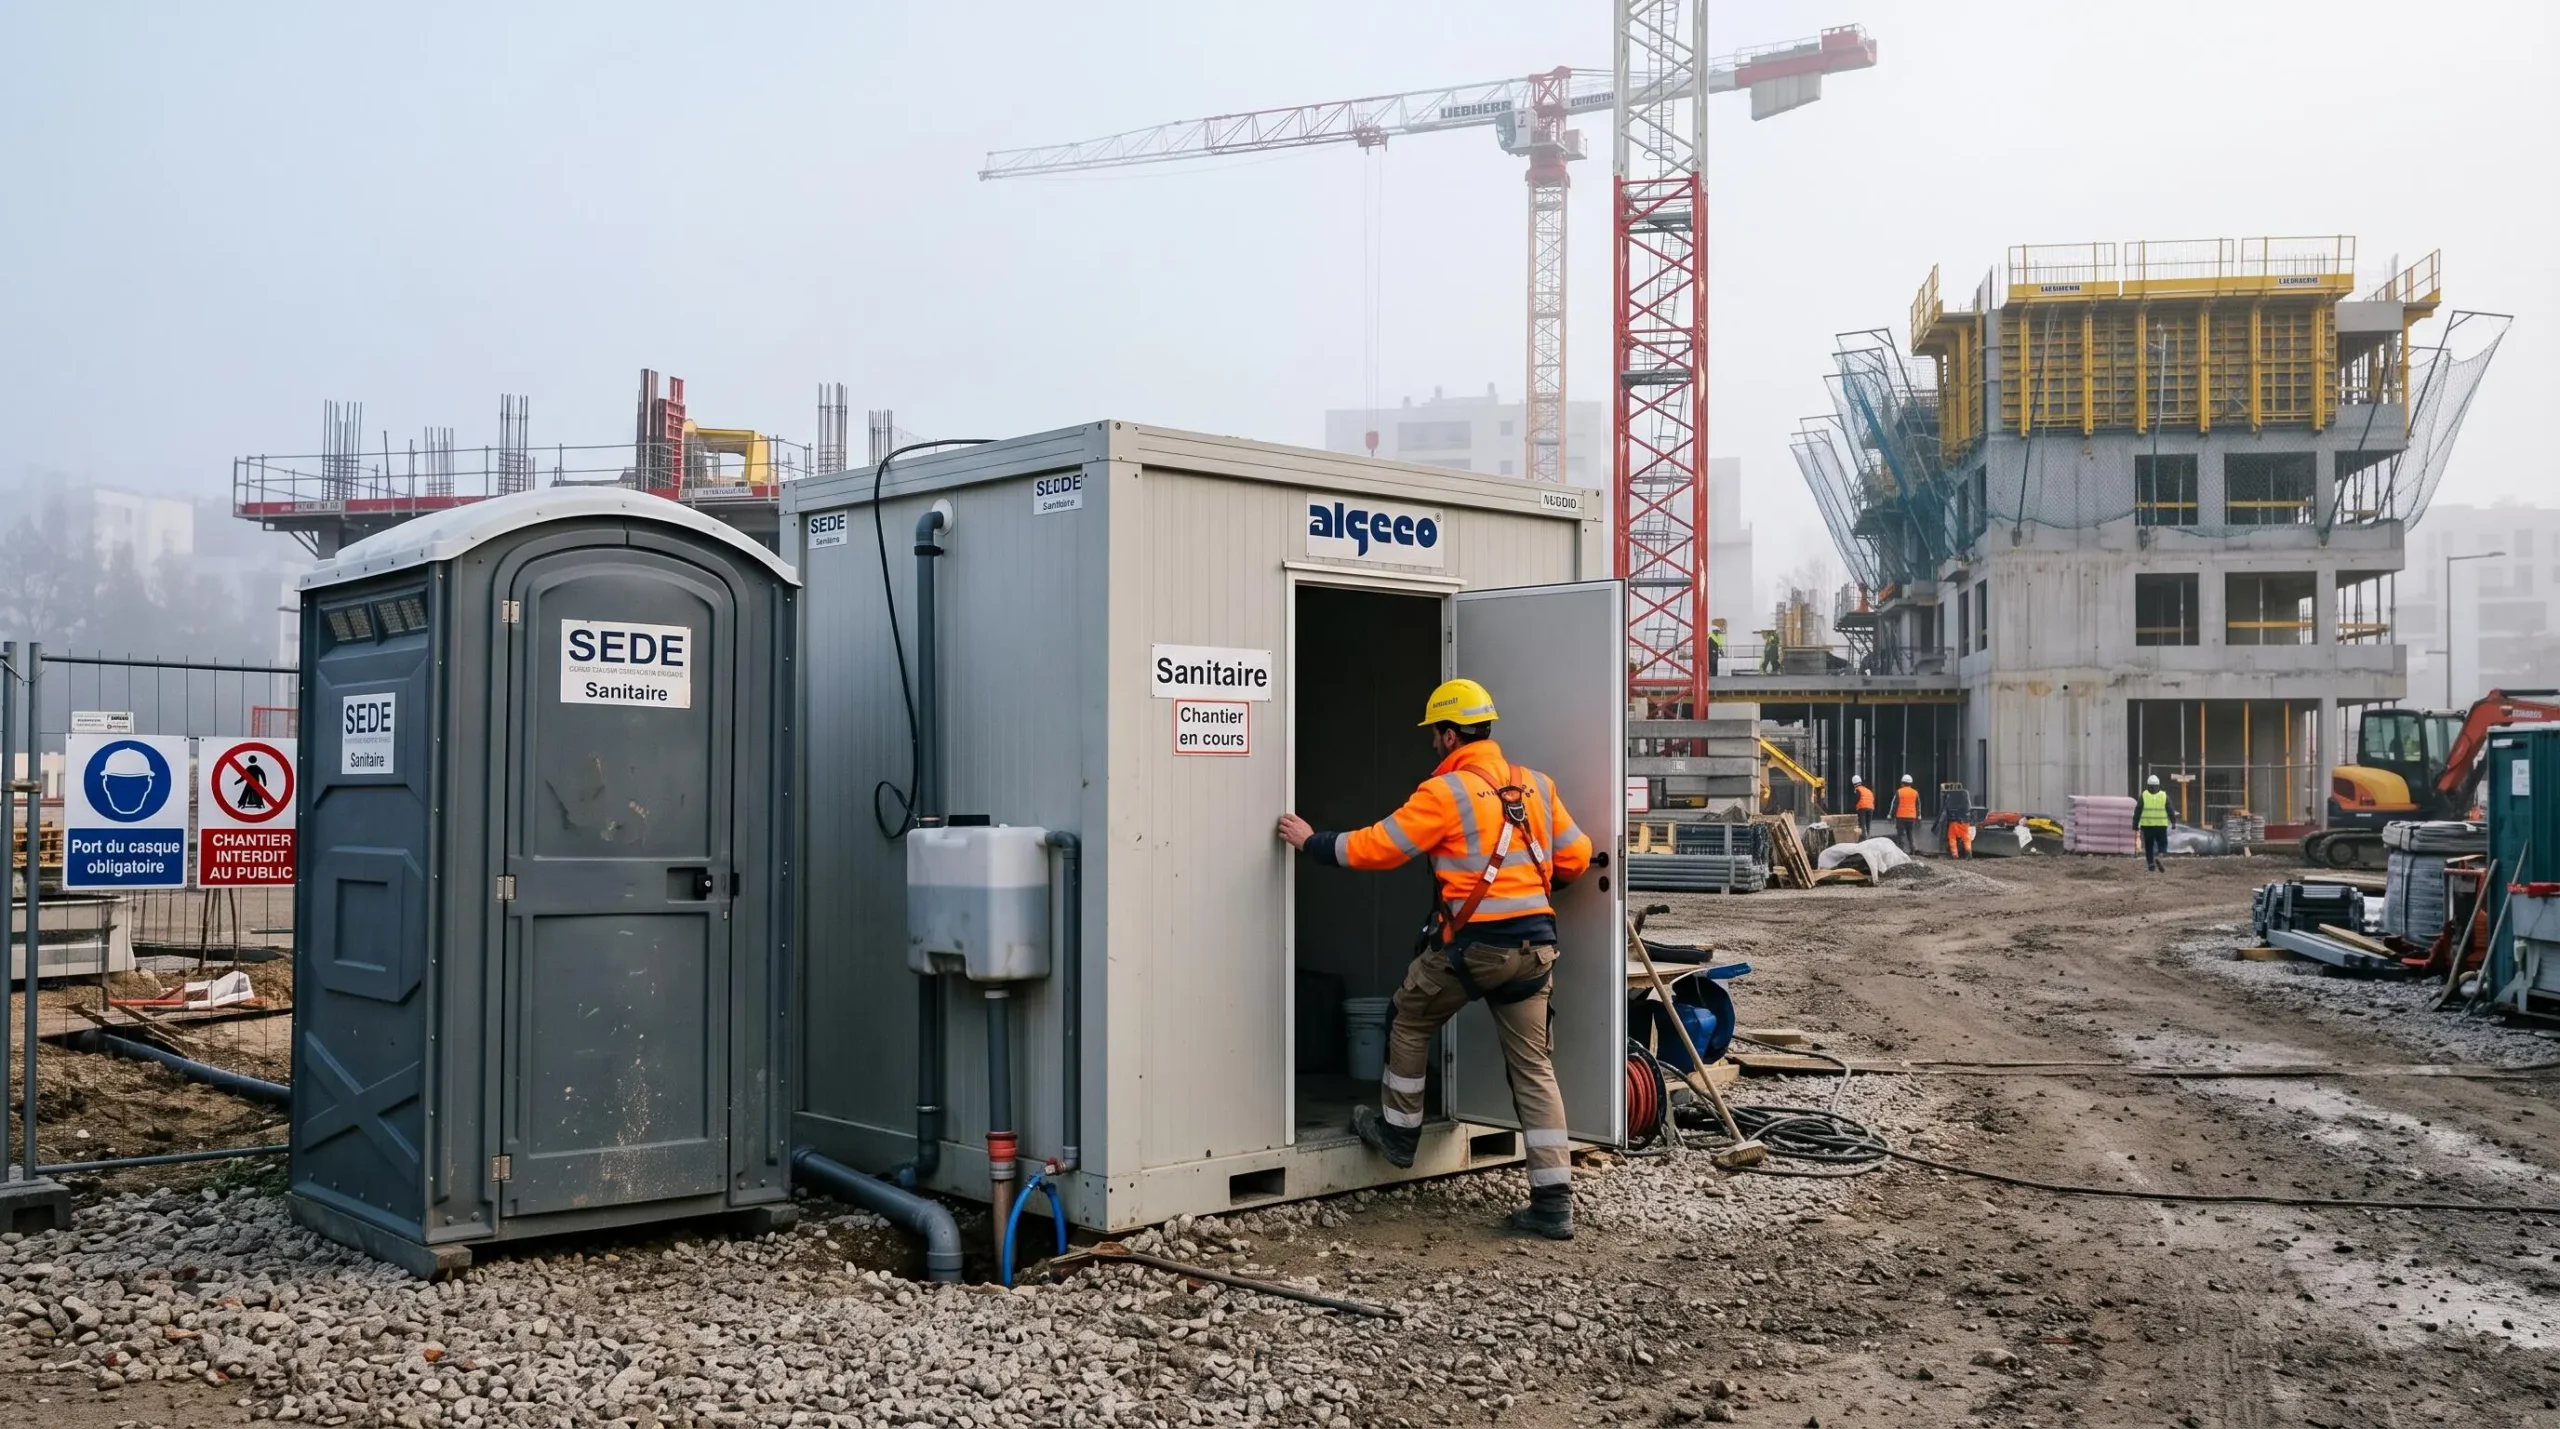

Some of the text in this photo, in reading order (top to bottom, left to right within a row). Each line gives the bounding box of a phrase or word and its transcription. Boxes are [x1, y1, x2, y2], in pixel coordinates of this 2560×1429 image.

[1440, 101, 1512, 119] LIEBHERR
[811, 514, 846, 534] SEDE
[568, 629, 684, 667] SEDE
[1157, 657, 1268, 687] Sanitaire
[585, 682, 668, 701] Sanitaire
[345, 702, 392, 735] SEDE
[1180, 707, 1244, 724] Chantier
[1180, 733, 1244, 746] en cours
[350, 752, 385, 768] Sanitaire
[72, 839, 180, 857] Port du casque
[212, 833, 292, 847] CHANTIER
[216, 850, 287, 863] INTERDIT
[87, 858, 165, 877] obligatoire
[209, 866, 293, 879] AU PUBLIC
